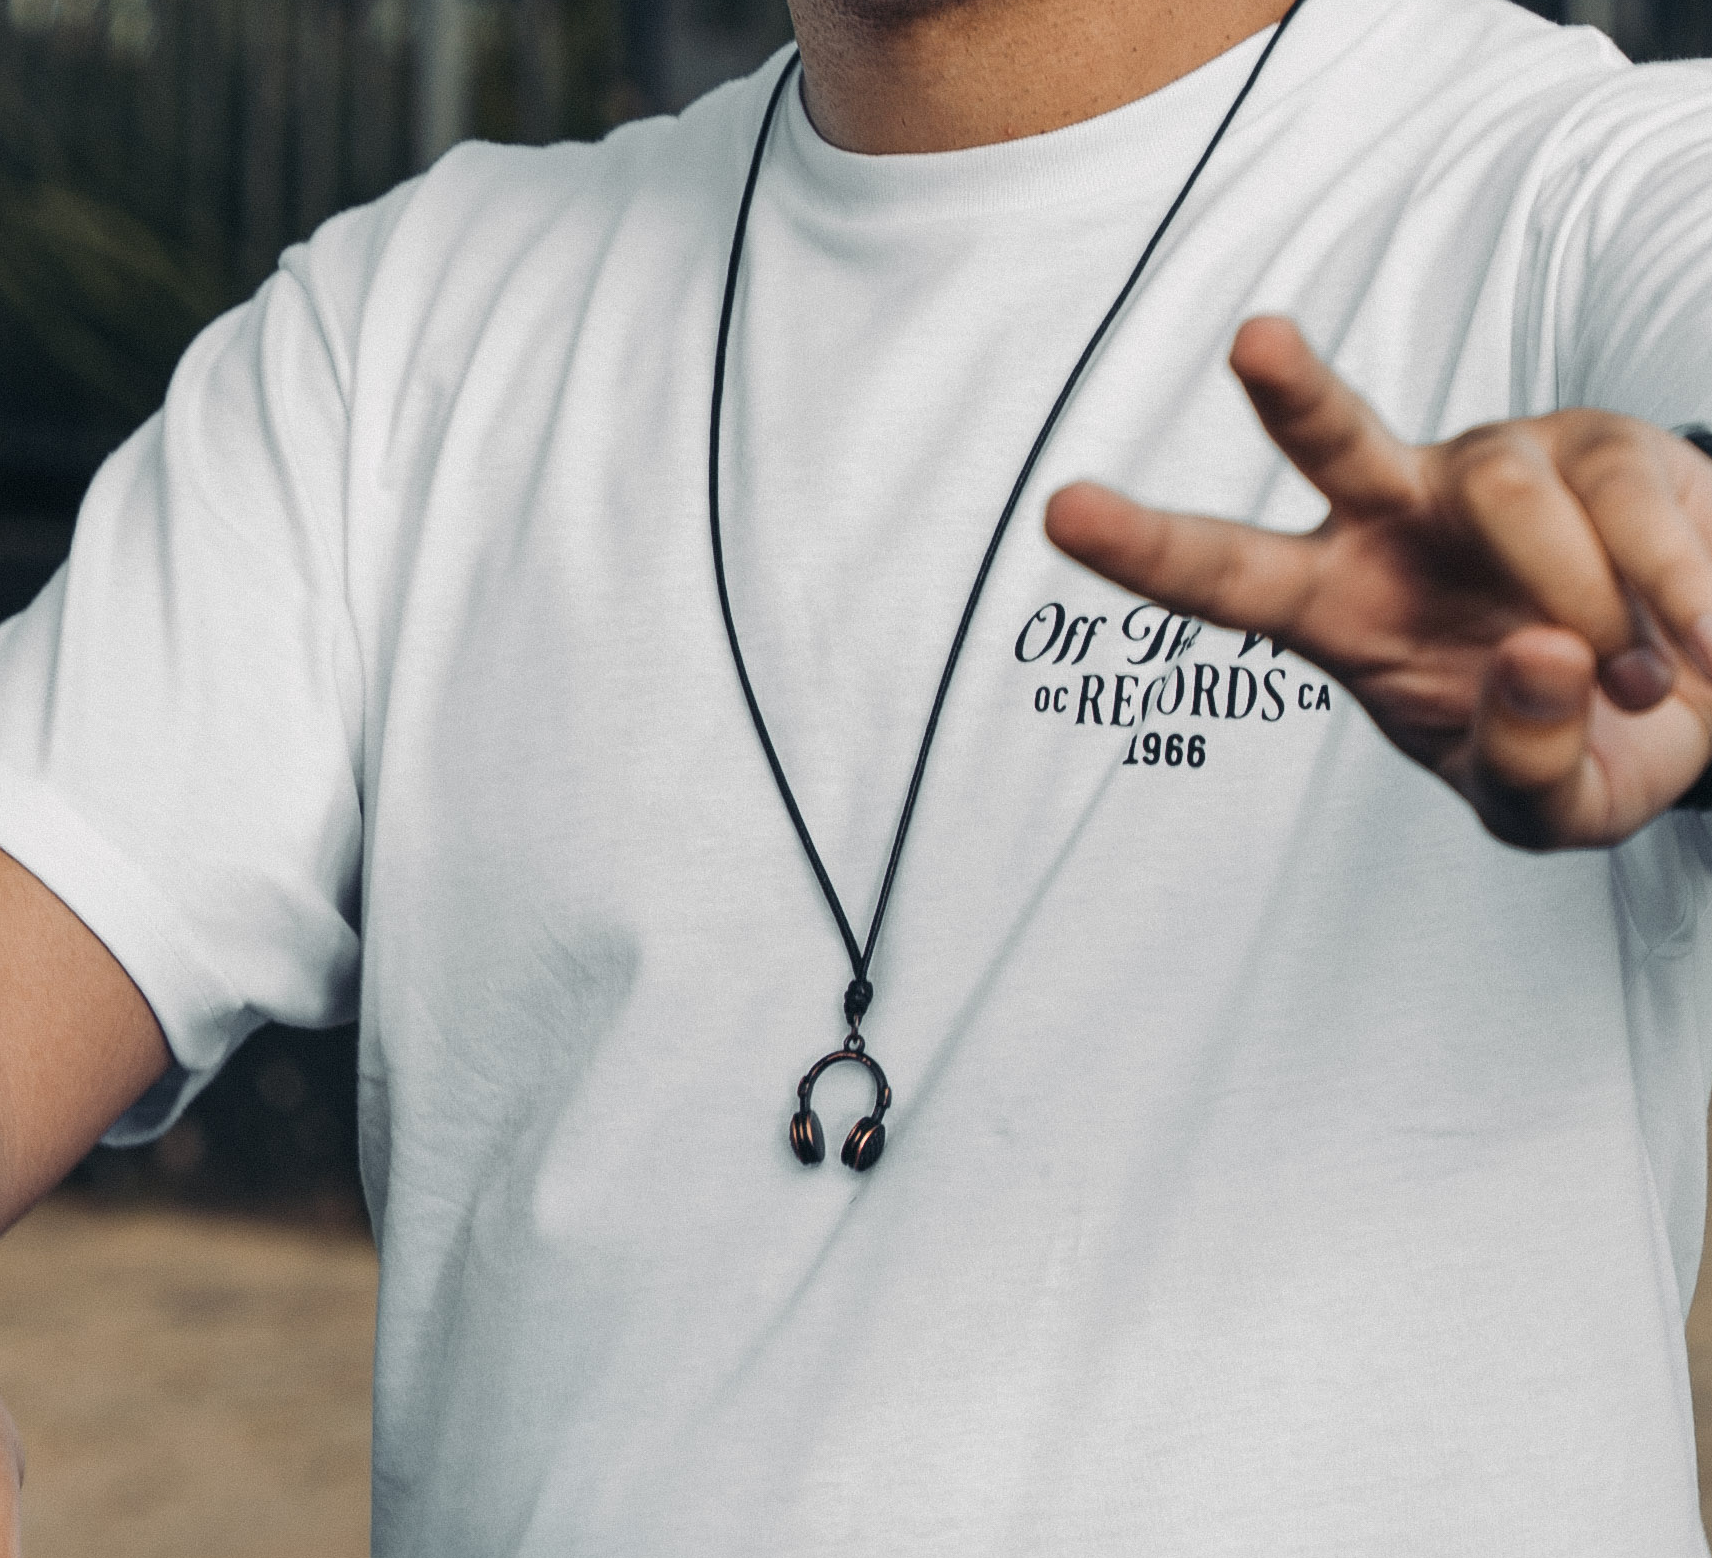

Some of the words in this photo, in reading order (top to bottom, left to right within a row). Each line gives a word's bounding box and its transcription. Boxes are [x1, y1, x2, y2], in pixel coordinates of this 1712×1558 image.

[1014, 602, 1107, 665] Off
[1034, 686, 1068, 713] OC
[1075, 663, 1286, 727] RECORDS
[1297, 683, 1331, 711] CA
[1122, 732, 1206, 768] 1966
